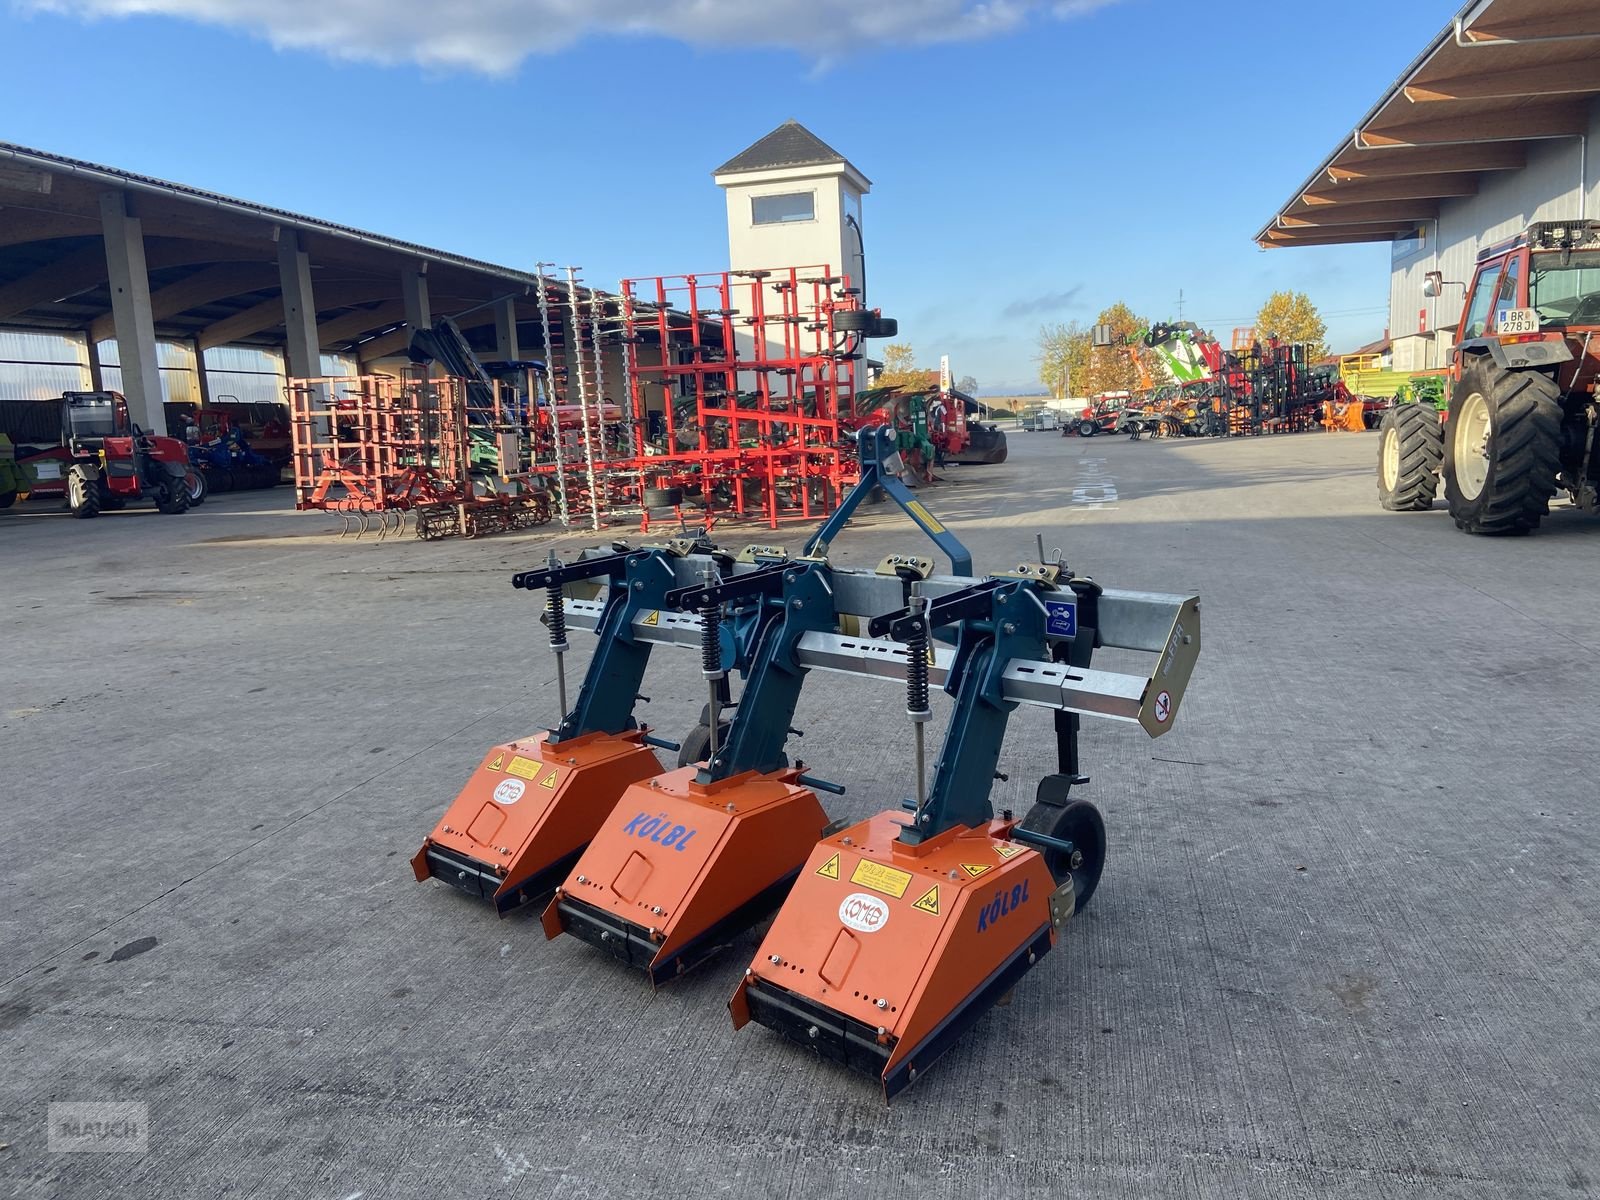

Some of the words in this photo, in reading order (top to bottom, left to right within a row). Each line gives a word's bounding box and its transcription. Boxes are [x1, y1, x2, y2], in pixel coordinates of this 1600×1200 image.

[1503, 322, 1522, 331] 278
[1511, 311, 1523, 320] BR
[623, 812, 697, 852] KÖLBL
[977, 878, 1029, 933] KÖLBL
